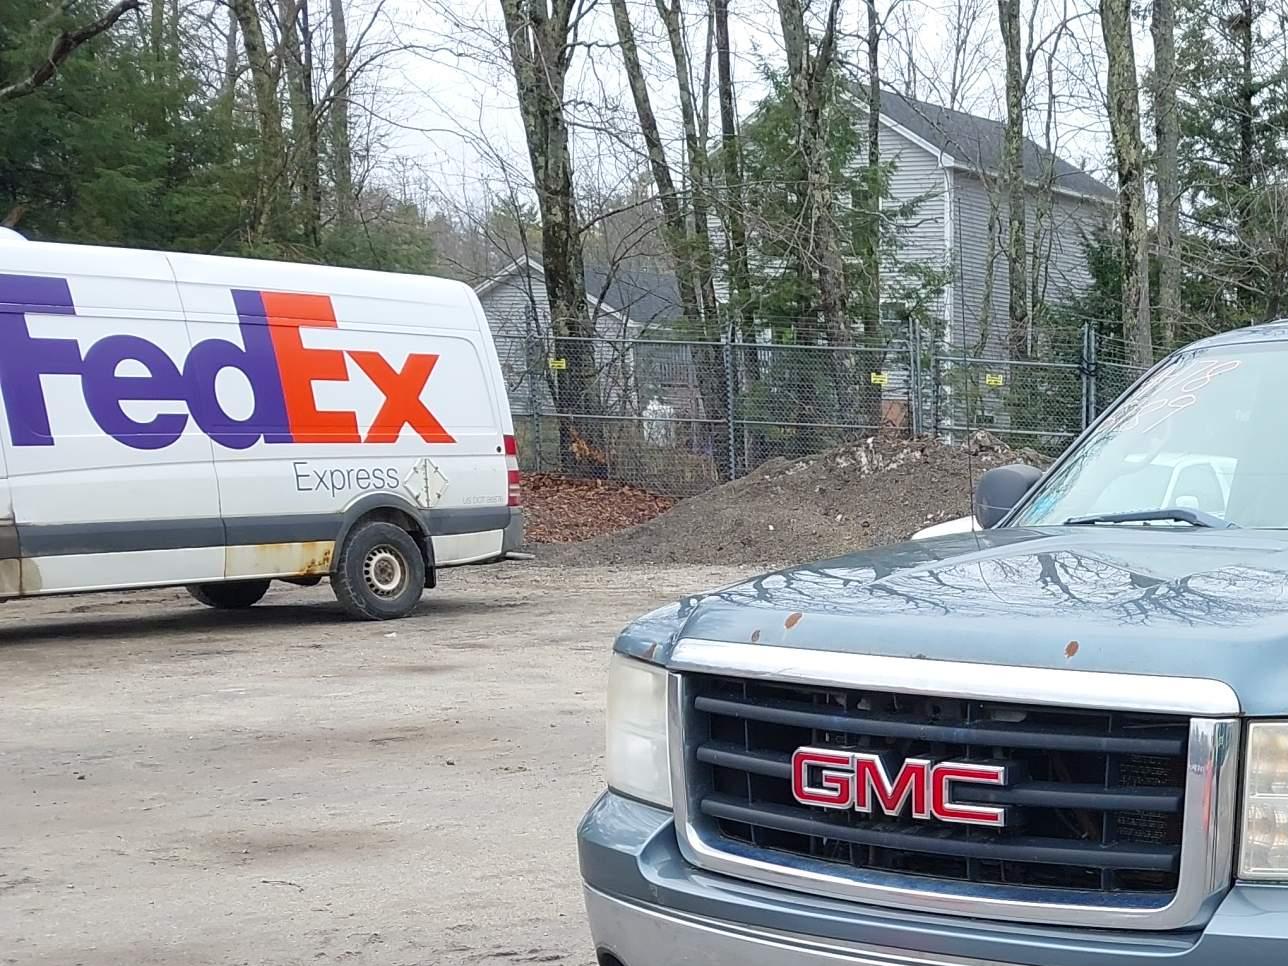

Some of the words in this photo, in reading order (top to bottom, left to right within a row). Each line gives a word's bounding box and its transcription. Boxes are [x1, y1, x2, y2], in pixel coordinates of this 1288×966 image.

[0, 273, 457, 450] FedEx
[292, 462, 400, 497] Express
[791, 746, 1006, 827] GMC
